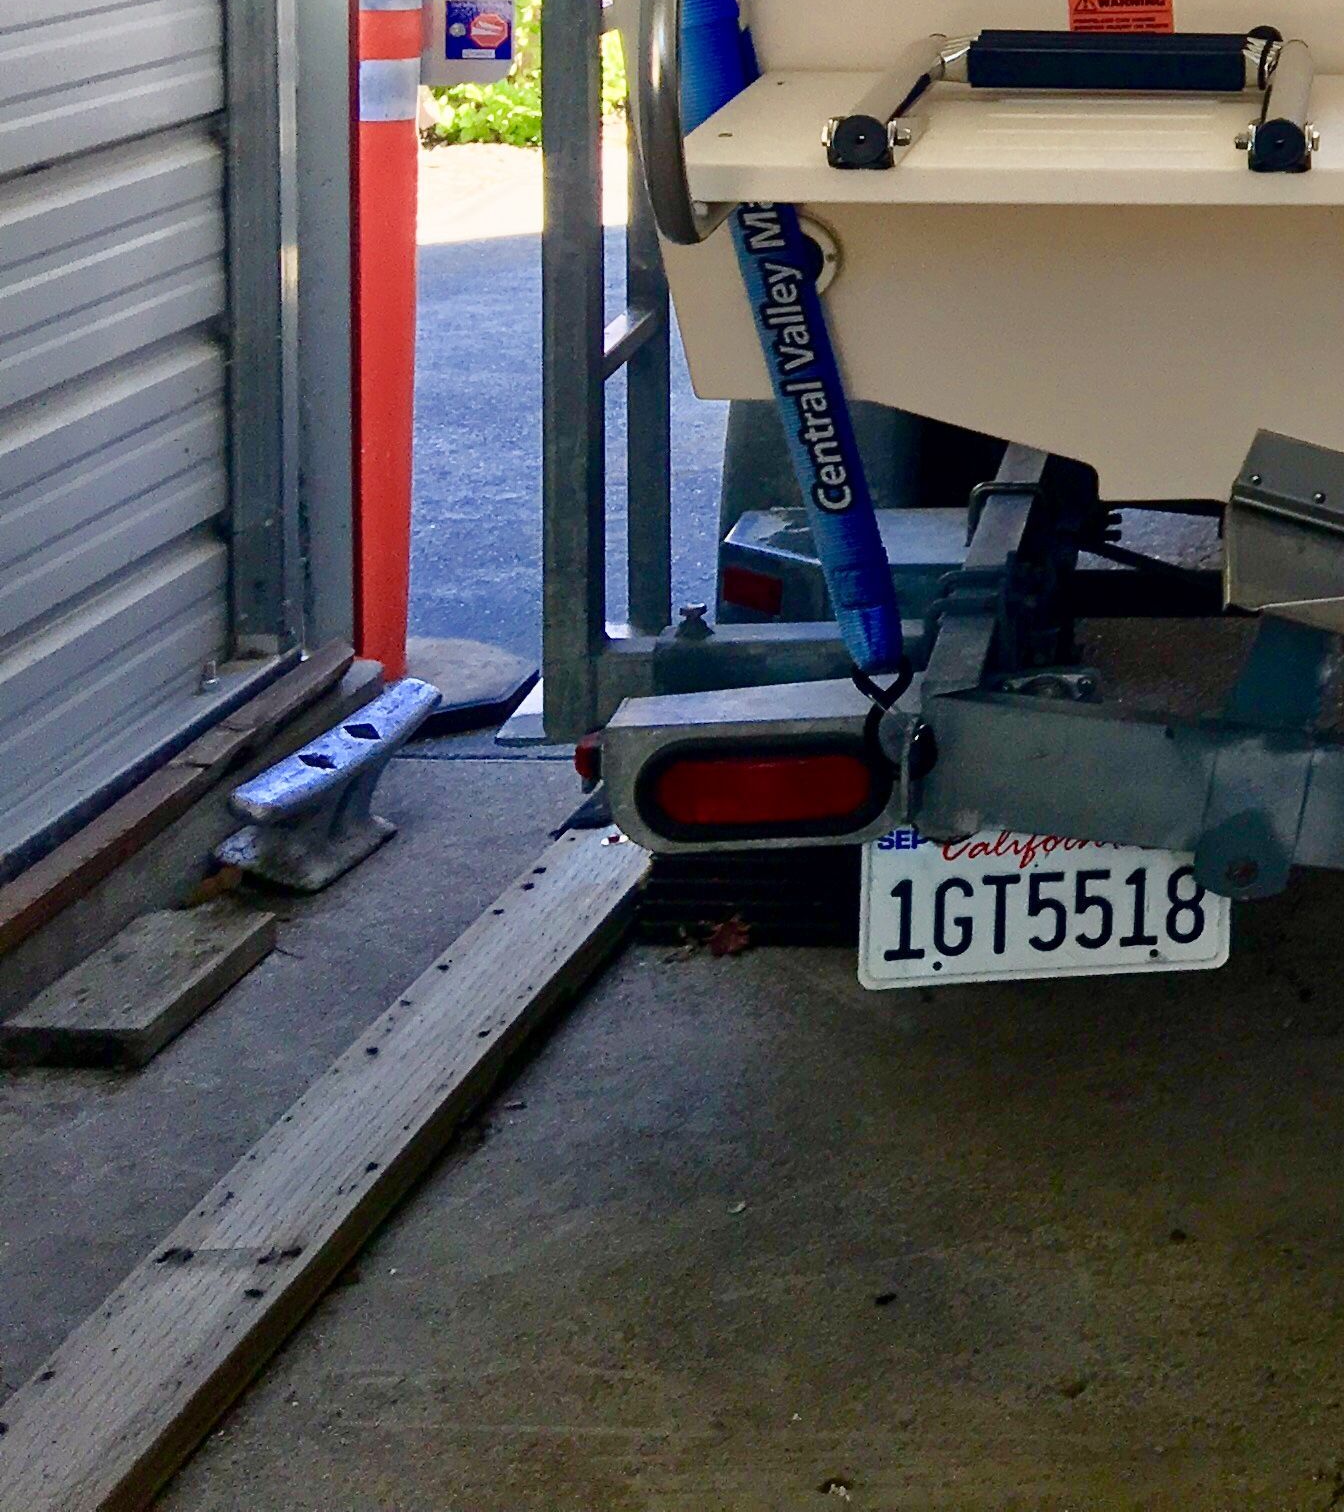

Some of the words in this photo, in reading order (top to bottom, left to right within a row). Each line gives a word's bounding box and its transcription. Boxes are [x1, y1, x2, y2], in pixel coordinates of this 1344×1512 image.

[764, 262, 815, 376] Valley
[785, 376, 854, 512] Central
[883, 866, 1205, 962] 1GT5518
